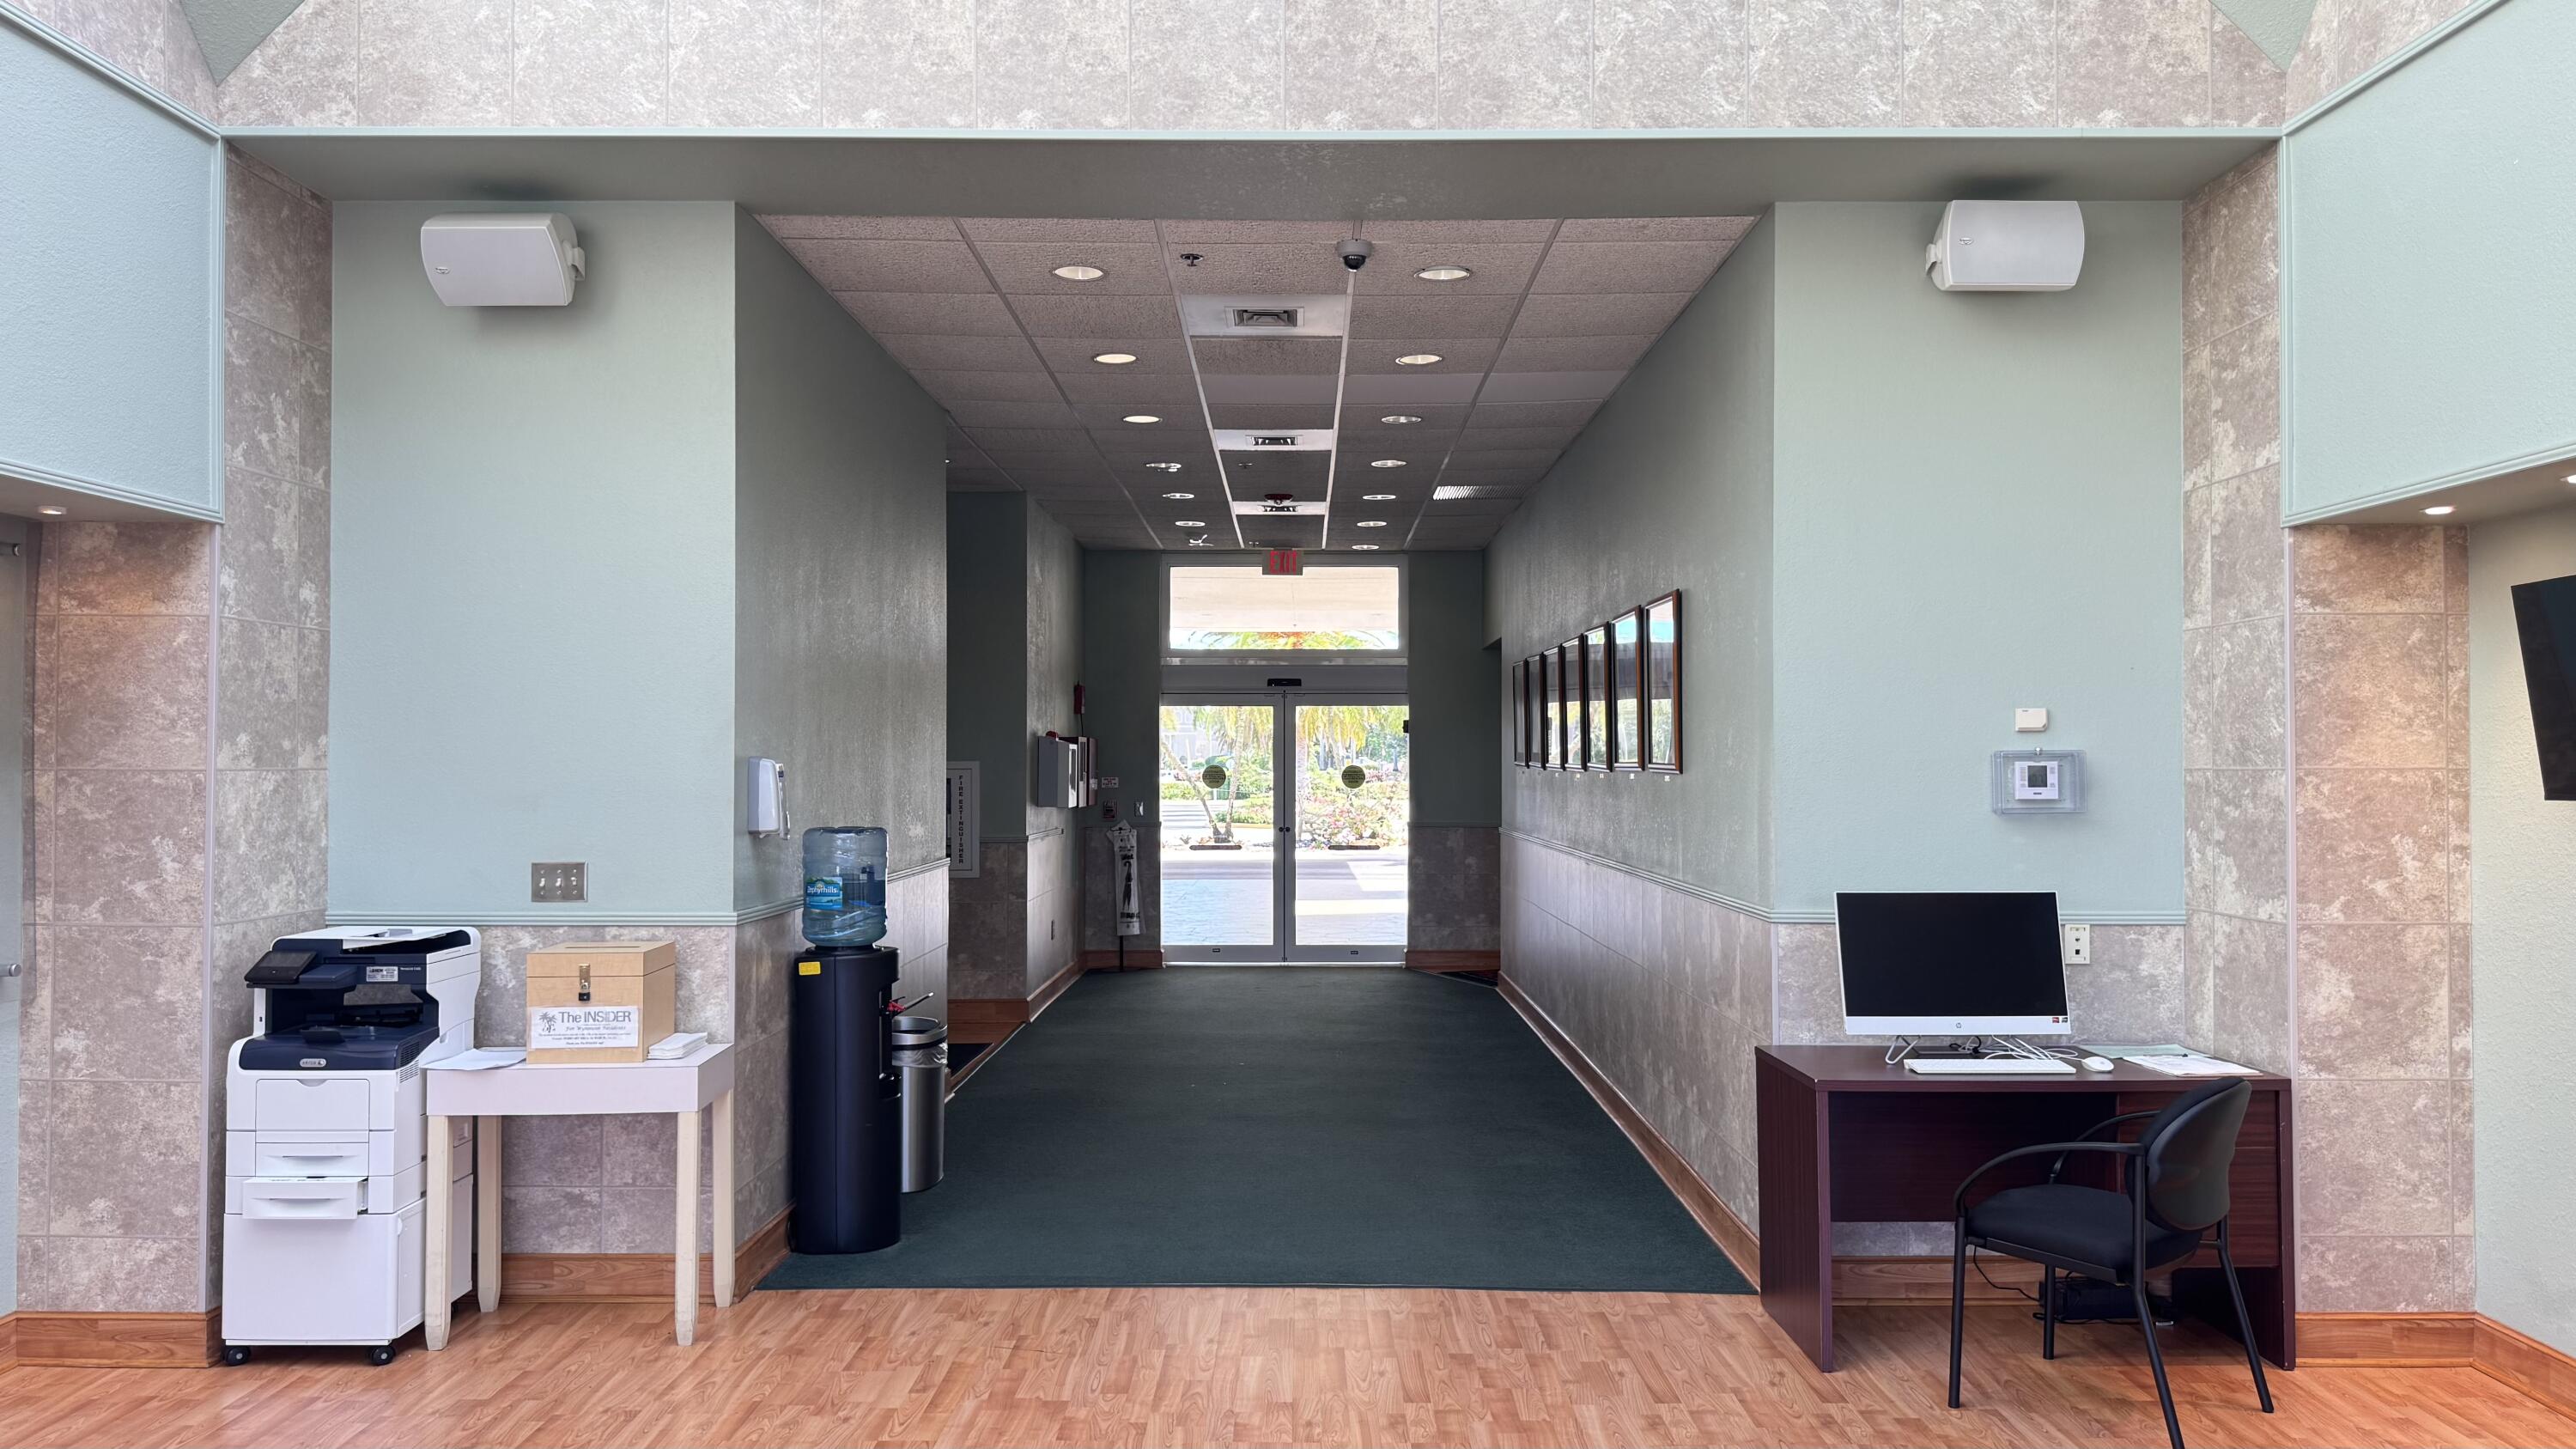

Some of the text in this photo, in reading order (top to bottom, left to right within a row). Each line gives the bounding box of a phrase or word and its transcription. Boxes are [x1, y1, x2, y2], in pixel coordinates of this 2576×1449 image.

[1270, 550, 1297, 575] EXIT
[806, 886, 838, 894] Zephyrhills
[558, 1011, 631, 1023] The INSIDER
